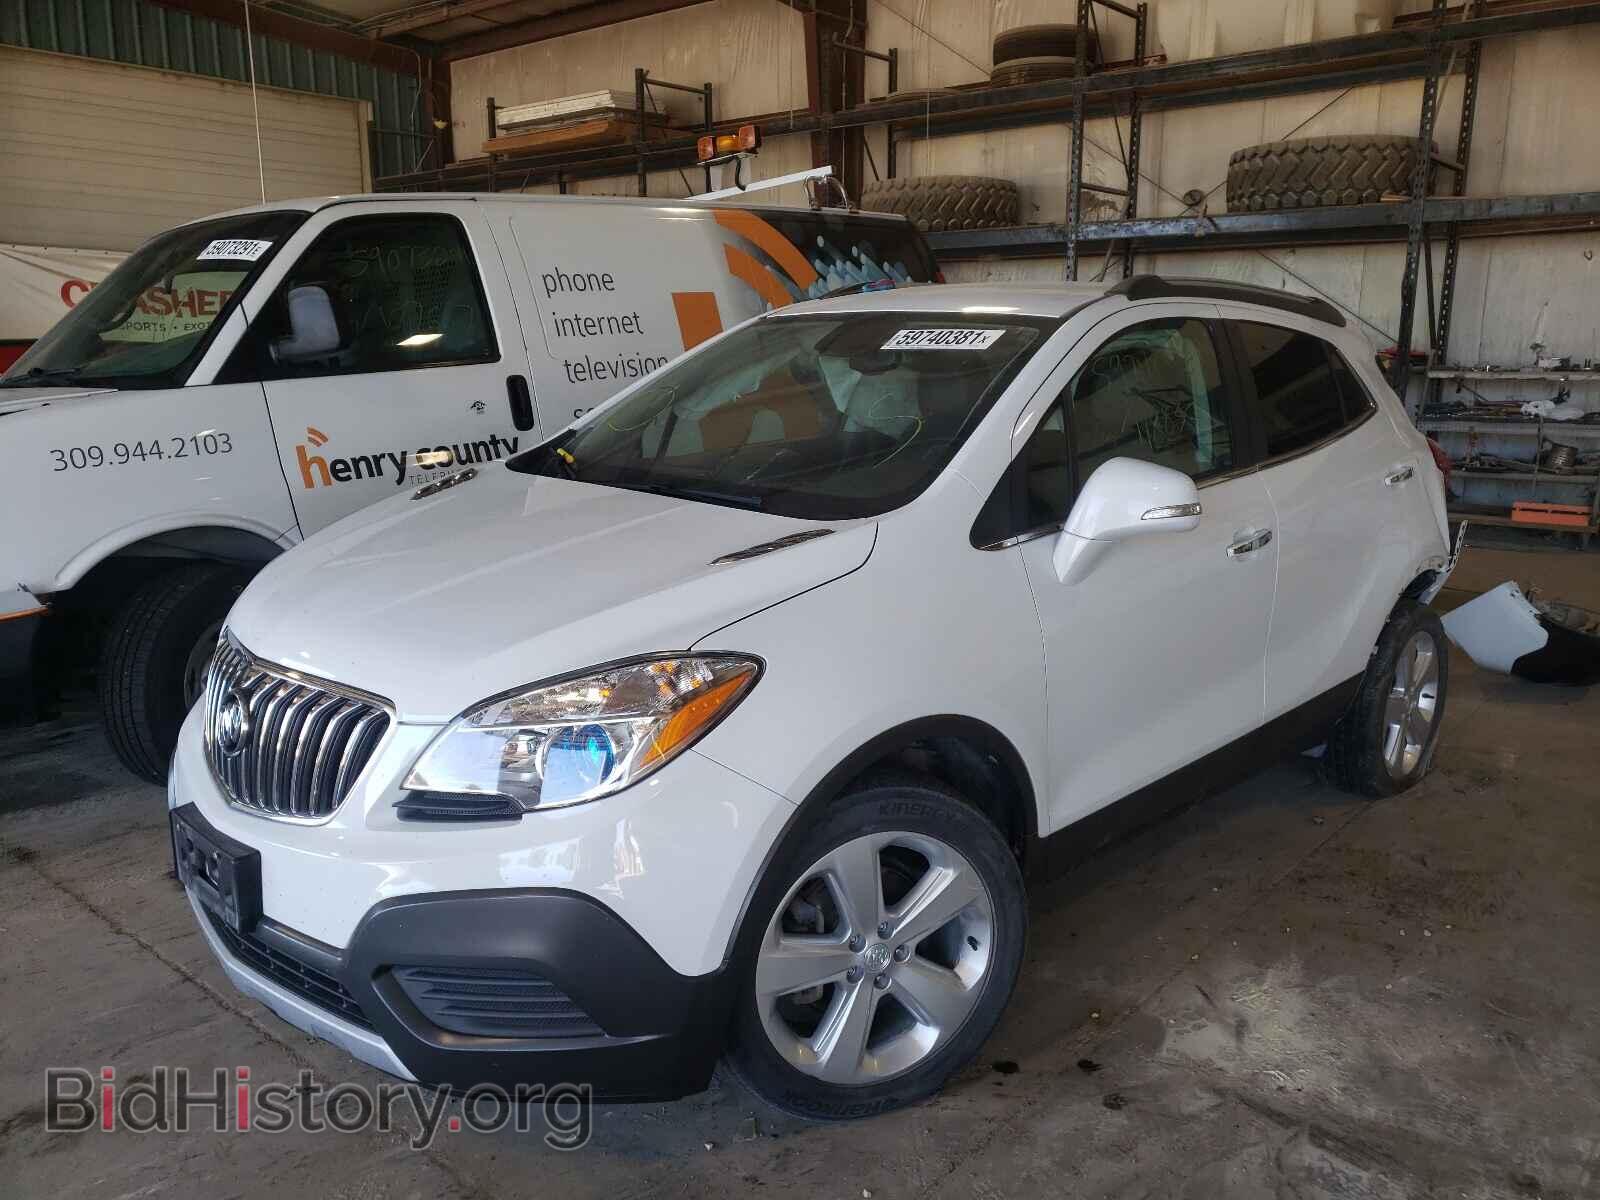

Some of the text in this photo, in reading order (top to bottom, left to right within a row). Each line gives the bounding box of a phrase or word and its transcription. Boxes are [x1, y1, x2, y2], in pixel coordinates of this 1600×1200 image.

[542, 266, 616, 299] phone
[120, 321, 167, 332] PORTS
[552, 311, 645, 338] internet
[49, 432, 233, 472] 309.944.2103
[295, 433, 519, 489] henry county
